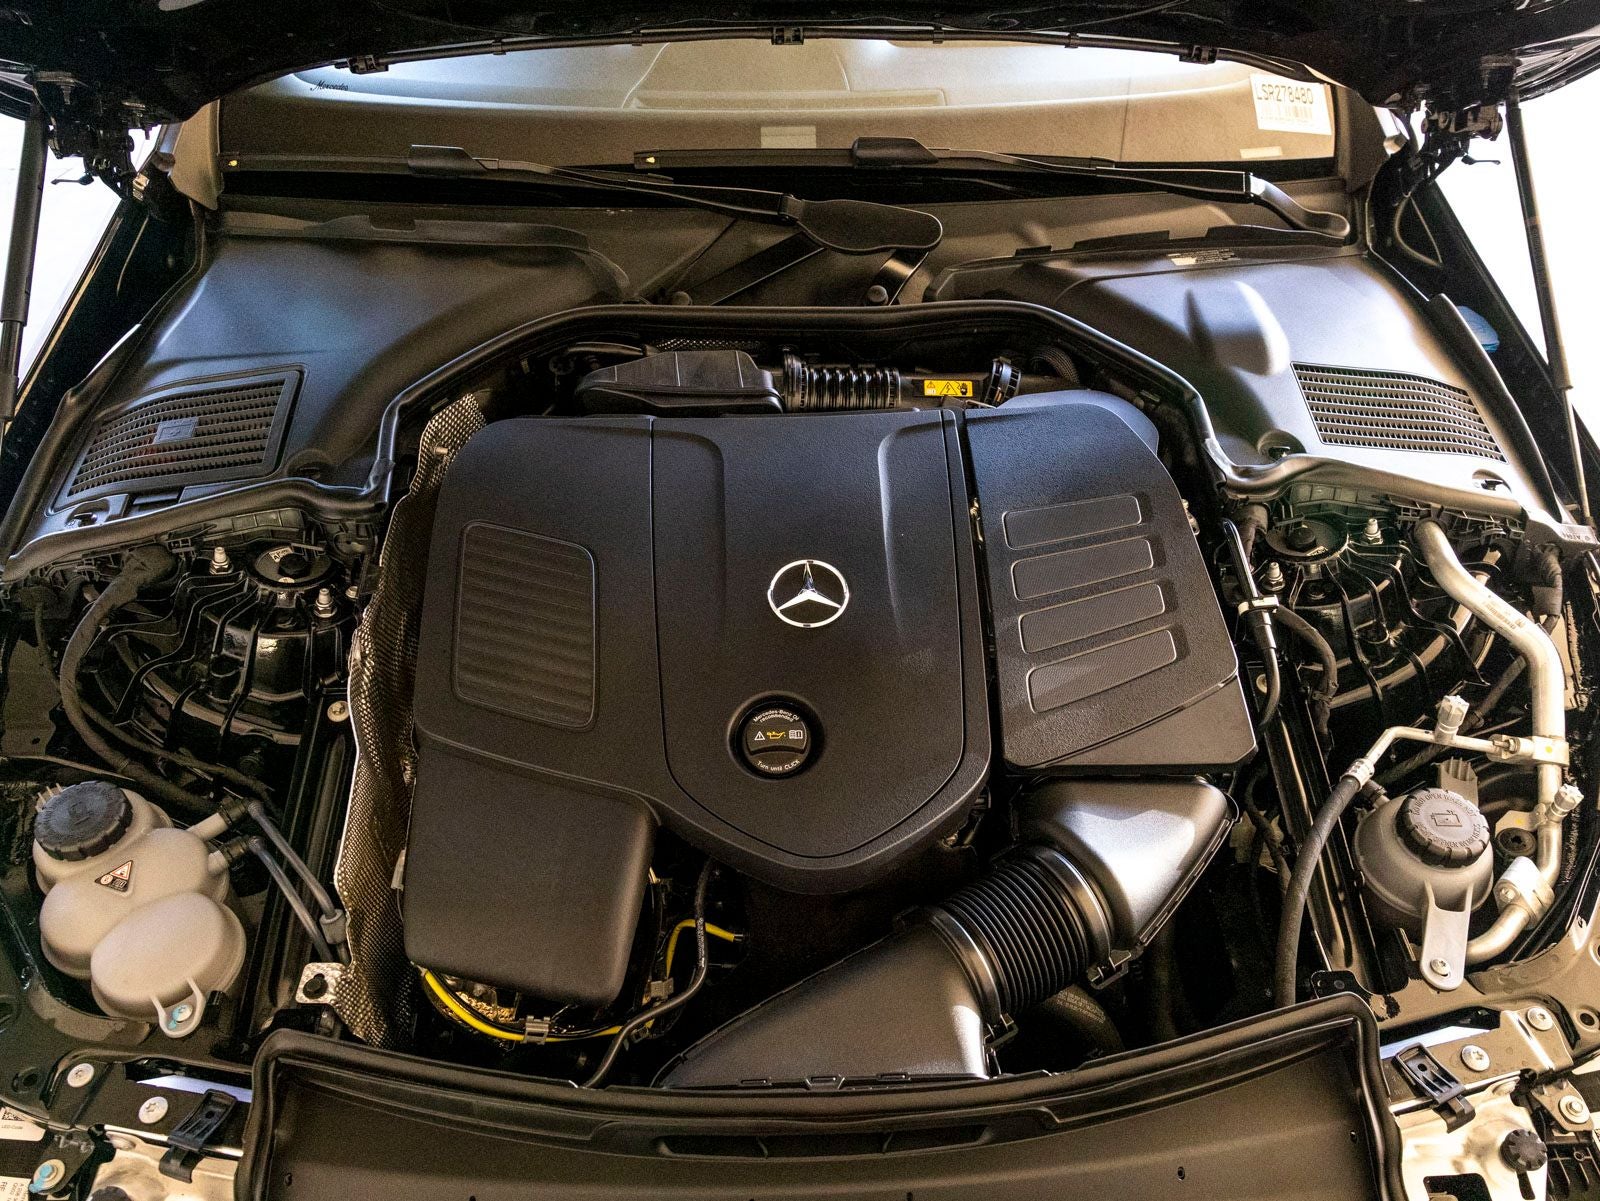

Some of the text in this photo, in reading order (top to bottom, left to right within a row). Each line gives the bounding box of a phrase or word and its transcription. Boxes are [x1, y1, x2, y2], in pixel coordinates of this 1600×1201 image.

[753, 709, 793, 722] Mercedes-Benz
[757, 761, 769, 770] Turn
[784, 759, 800, 770] CLICK
